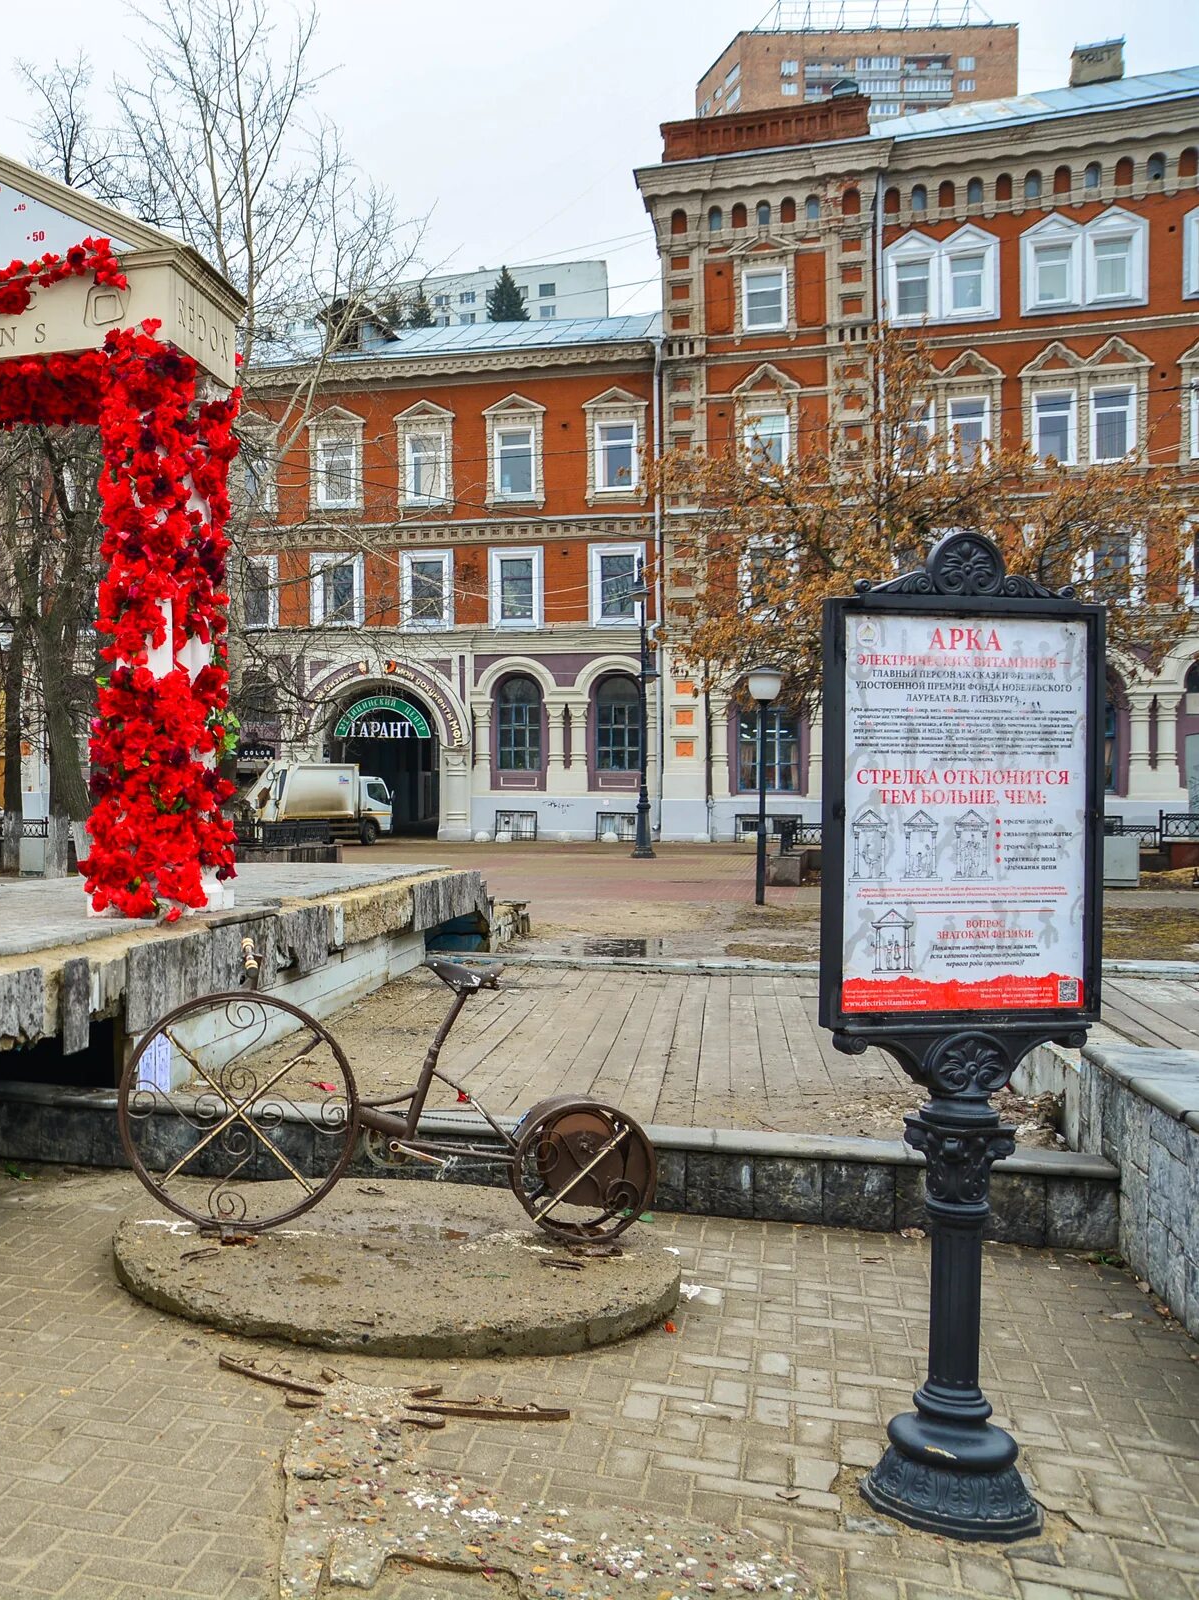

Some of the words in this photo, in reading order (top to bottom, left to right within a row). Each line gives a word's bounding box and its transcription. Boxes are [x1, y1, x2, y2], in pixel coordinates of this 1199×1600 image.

[32, 231, 45, 242] 50
[177, 297, 228, 362] REDOX
[928, 627, 1002, 651] АРКА
[857, 653, 971, 668] ЭЛЕКТРИЧЕСКИХ
[974, 656, 1057, 669] ВИТАМИНОВ
[323, 671, 354, 693] бизнес
[872, 669, 917, 679] ГЛАВНЫЙ
[919, 670, 971, 679] ПЕРСОНАЖ
[972, 672, 1008, 680] СКАЗКИ
[855, 680, 925, 691] УДОСТОЕННОЙ
[928, 682, 965, 690] ПРЕМИИ
[968, 683, 1001, 692] ФОНДА
[1002, 683, 1073, 692] НОБЕЛЕВСКОГО
[905, 694, 951, 703] ЛАУРЕАТА
[953, 695, 969, 703] В.Л.
[338, 698, 397, 733] МЕДИЦИНСКИЙ
[404, 705, 427, 732] ЦЕНТР
[415, 677, 455, 721] документы
[448, 720, 463, 747] МФЦ
[350, 720, 413, 739] ГАРАНТ
[856, 769, 940, 785] СТРЕЛКА
[944, 769, 1069, 785] ОТКЛОНИТСЯ
[879, 789, 917, 804] ТЕМ
[921, 789, 1000, 806] БОЛЬШЕ,
[1004, 789, 1047, 805] ЧЕМ:
[966, 919, 1006, 928] ВОПРОС
[936, 930, 989, 940] ЗНАТОКАМ
[991, 929, 1034, 939] ФИЗИКИ:
